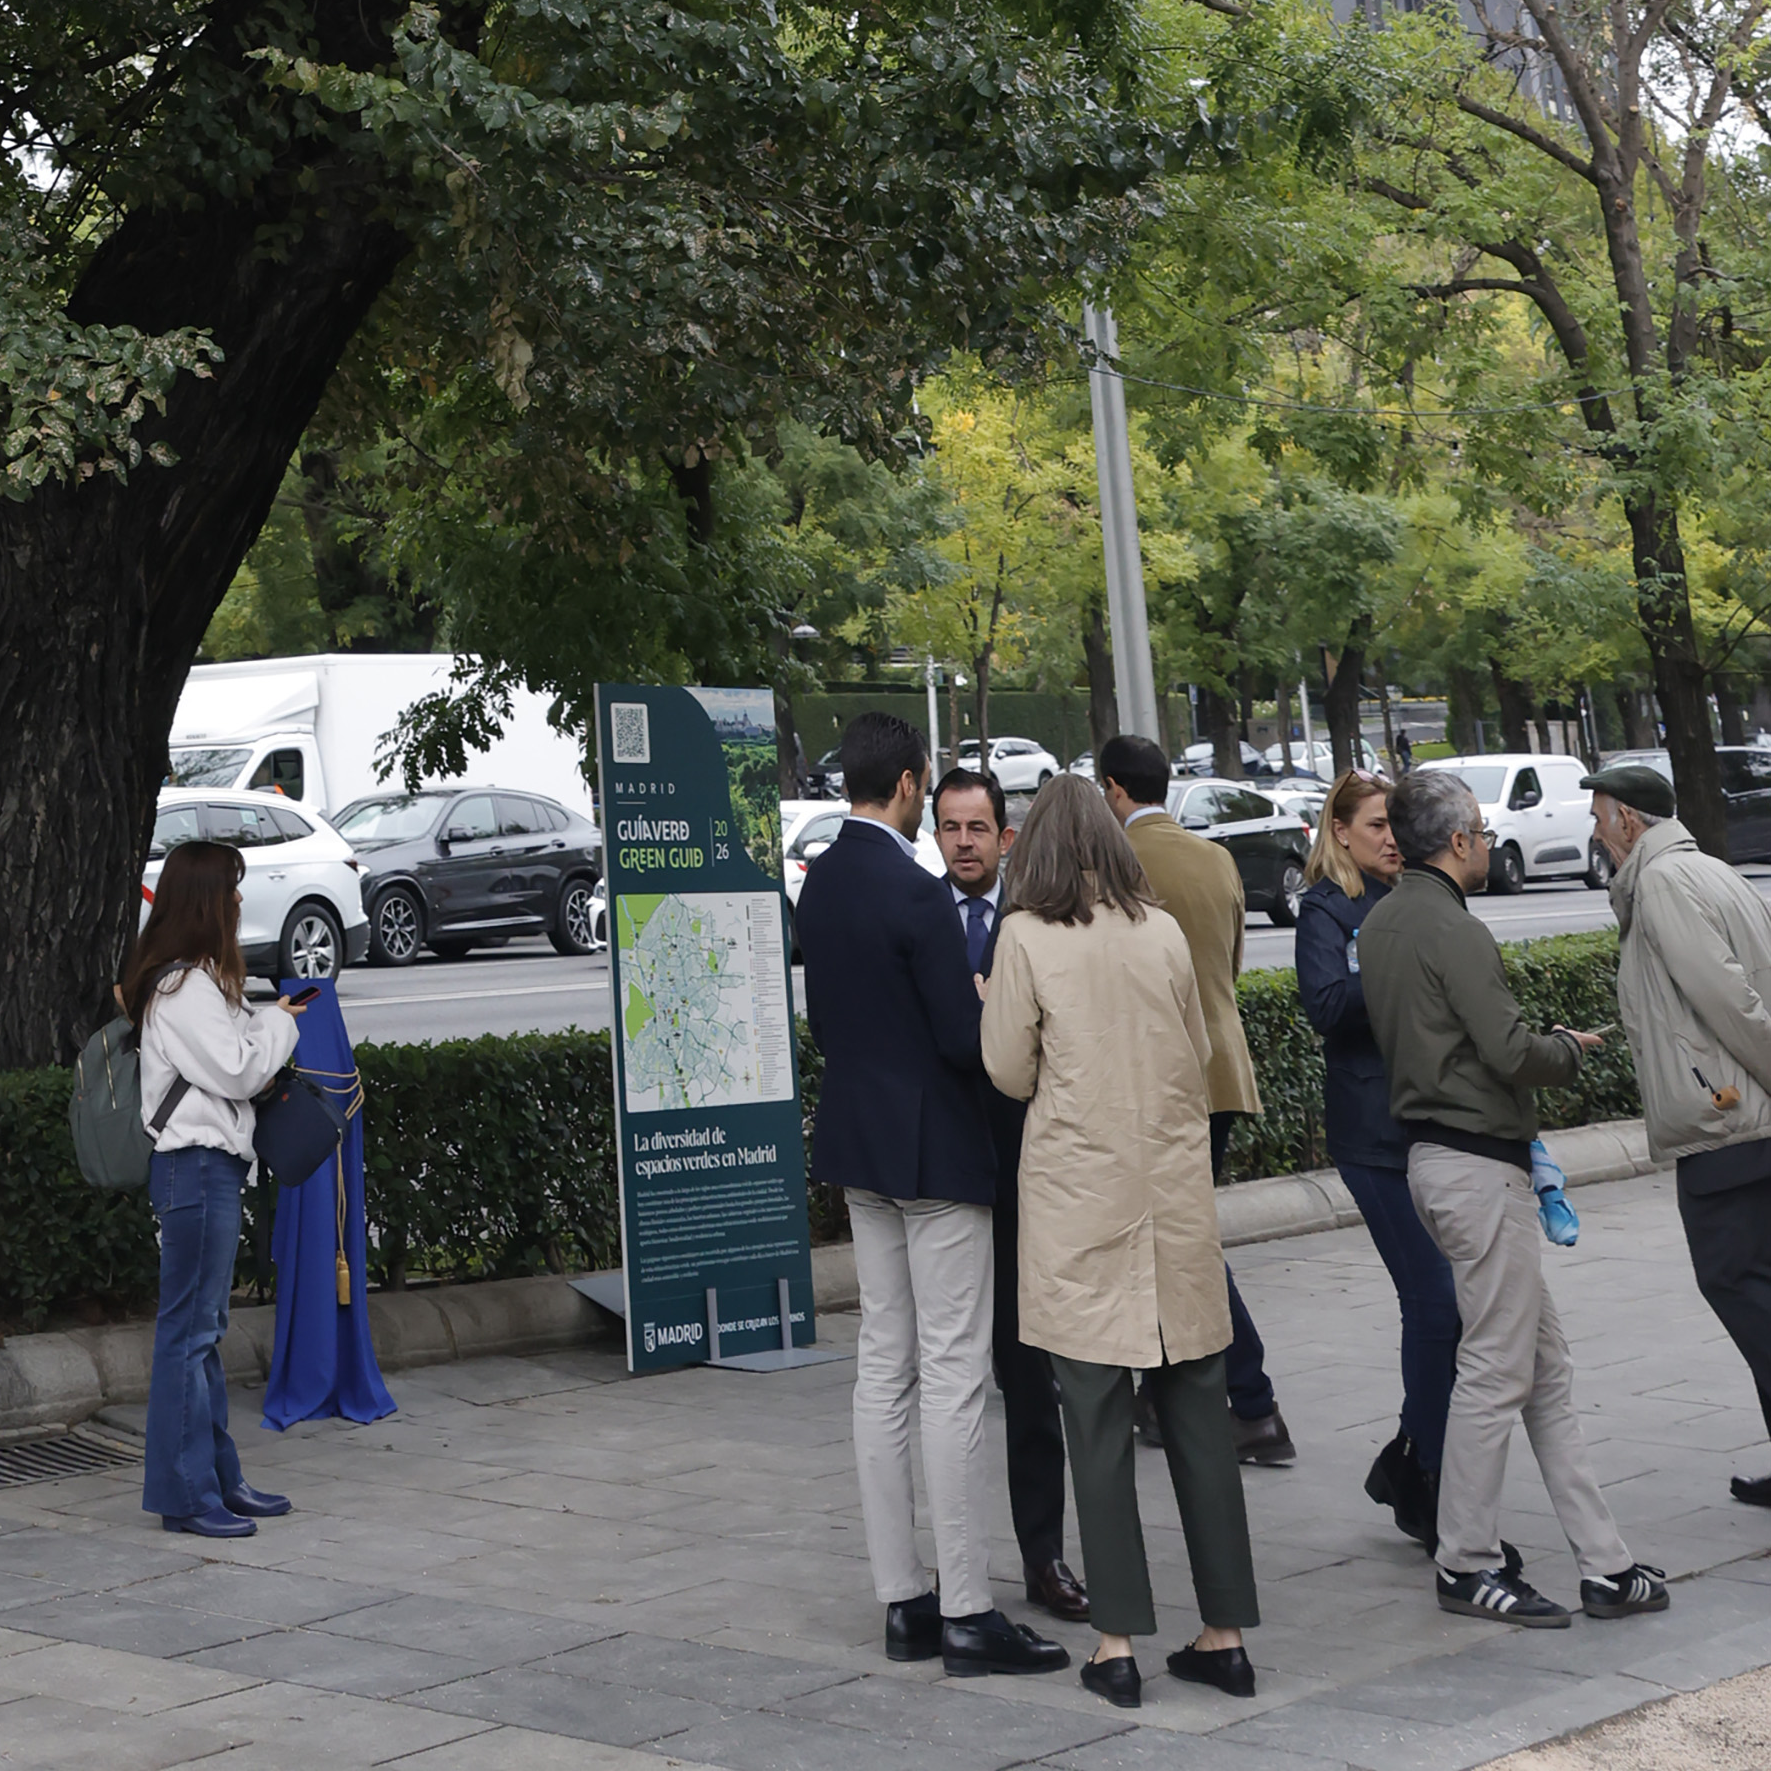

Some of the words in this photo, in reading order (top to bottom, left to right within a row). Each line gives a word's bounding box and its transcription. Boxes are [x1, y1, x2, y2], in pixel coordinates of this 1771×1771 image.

[615, 782, 675, 795] MADRID
[714, 820, 728, 837] 20
[619, 847, 666, 873] GREEN
[715, 843, 730, 860] 26
[634, 1133, 649, 1152] La
[651, 1127, 710, 1151] diversidad
[712, 1126, 726, 1145] de
[635, 1154, 682, 1180] espacios
[683, 1151, 721, 1171] verdes
[722, 1152, 736, 1168] en
[737, 1144, 777, 1166] Madrid
[657, 1322, 703, 1345] MADRID
